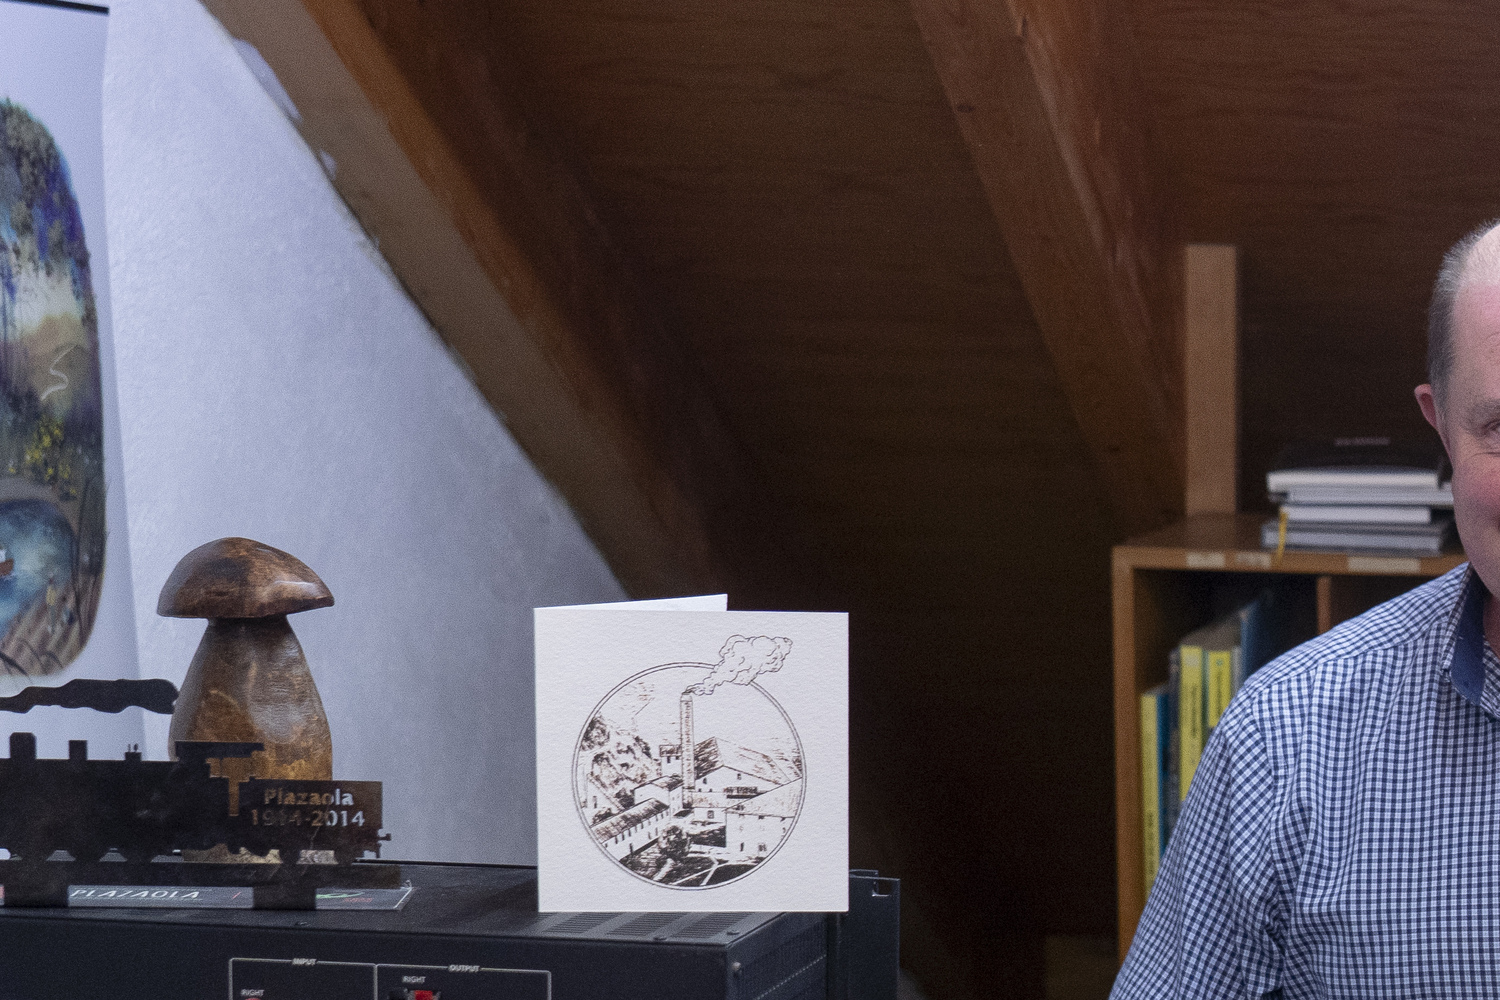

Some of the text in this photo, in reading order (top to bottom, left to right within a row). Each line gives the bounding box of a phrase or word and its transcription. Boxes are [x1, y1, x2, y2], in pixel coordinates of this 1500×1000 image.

[264, 788, 354, 806] Plazaola
[292, 958, 317, 966] INPUT
[448, 964, 480, 972] OUTPUT
[402, 975, 426, 983] RIGHT
[240, 989, 265, 997] RIGHT
